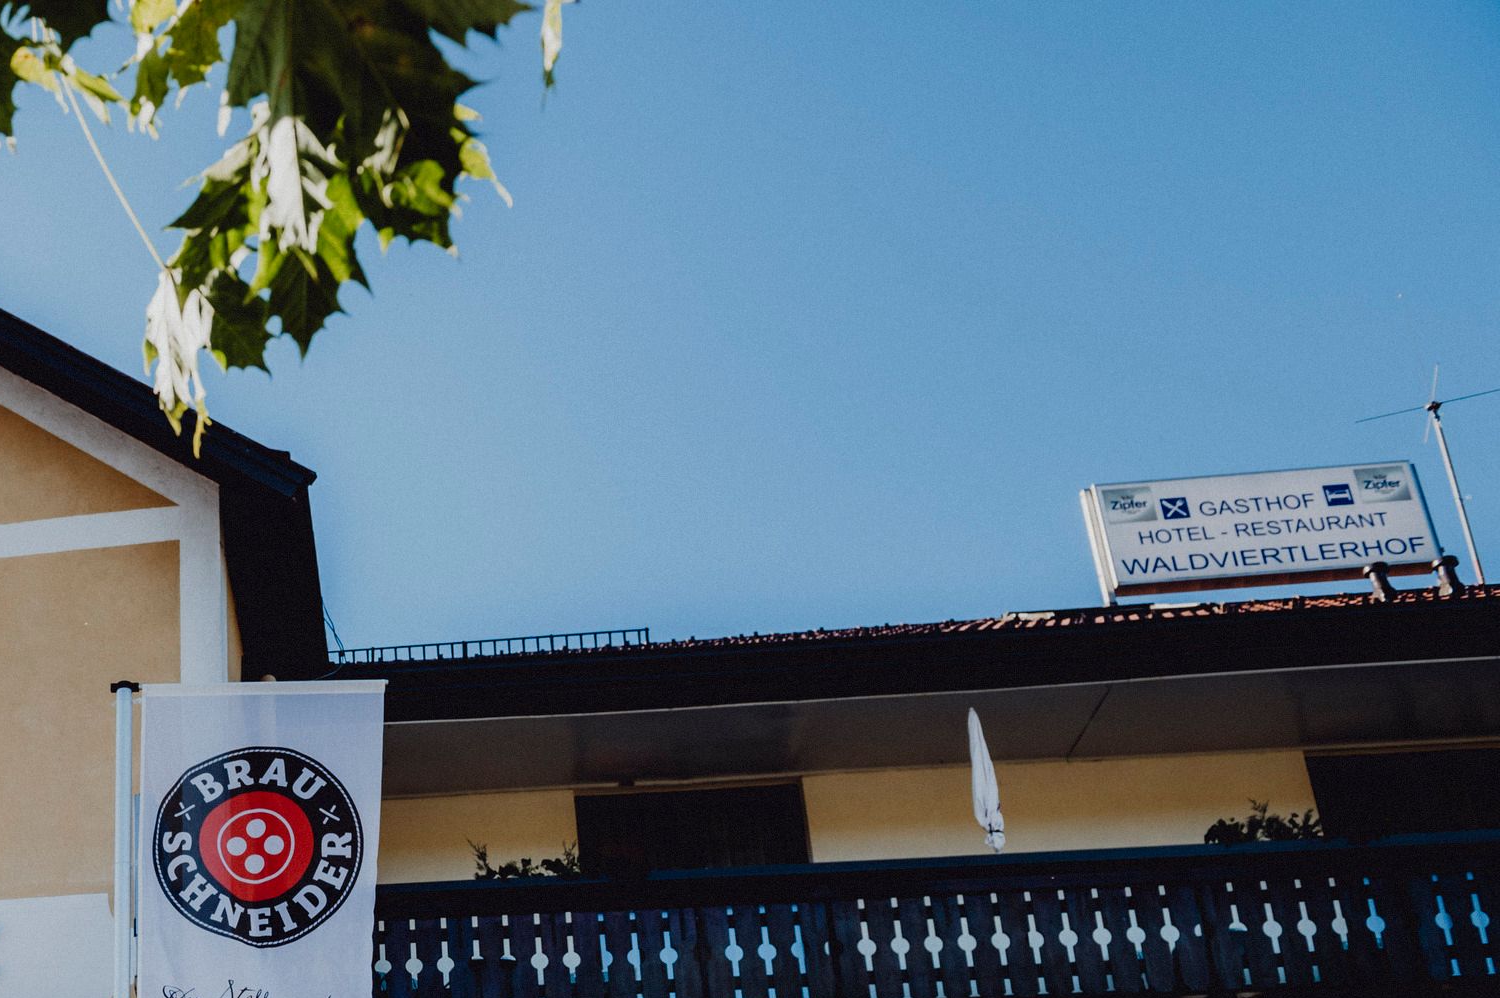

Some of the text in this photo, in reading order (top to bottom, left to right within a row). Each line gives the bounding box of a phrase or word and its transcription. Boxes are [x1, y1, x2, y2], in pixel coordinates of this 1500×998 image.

[1364, 479, 1400, 490] Zipfer
[1111, 499, 1148, 511] Zipfer
[1199, 493, 1315, 517] GASTHOF
[1138, 526, 1215, 545] HOTEL
[1234, 512, 1388, 538] RESTAURANT
[1121, 536, 1425, 576] WALDVIERTLERHOF
[190, 758, 327, 804] BRAU
[163, 830, 352, 937] SCHNEIDER
